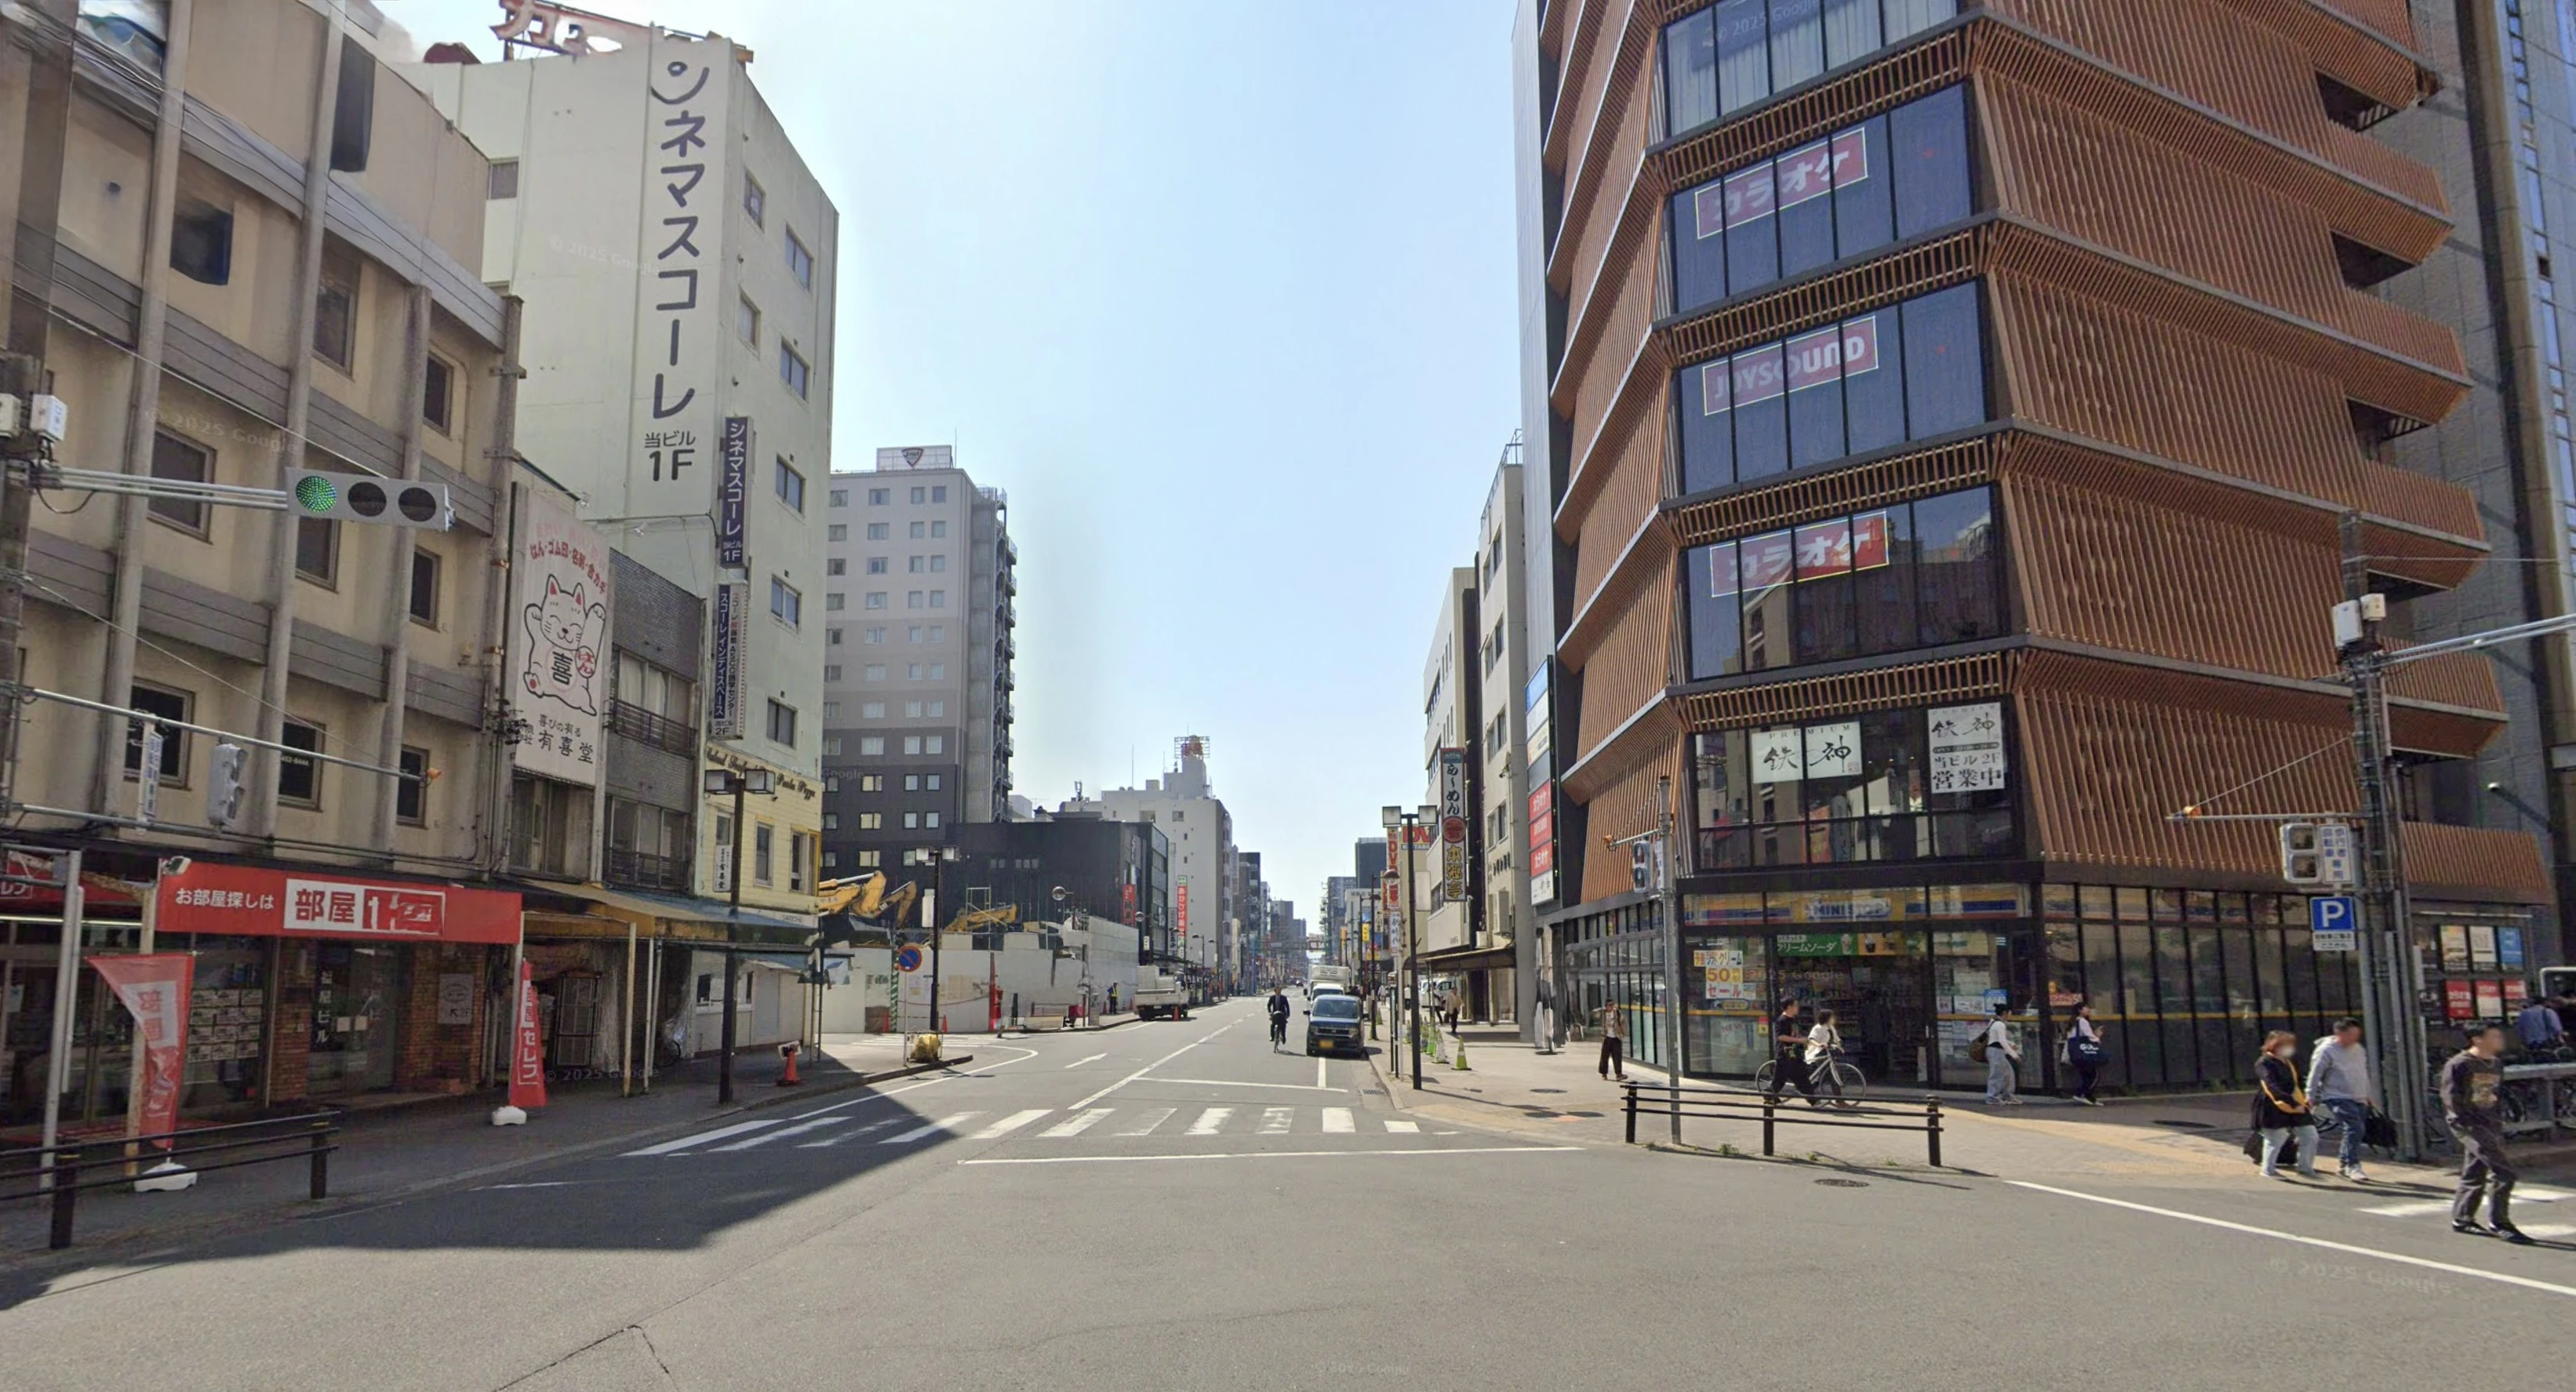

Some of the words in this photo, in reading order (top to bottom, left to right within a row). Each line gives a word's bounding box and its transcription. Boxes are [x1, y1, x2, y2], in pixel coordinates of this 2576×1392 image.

[1715, 150, 1850, 221] カラオケ
[650, 61, 709, 419] シネマスコーレ
[644, 431, 696, 448] 当ビル
[649, 449, 696, 482] 1F
[726, 422, 745, 536] シネマスコーレ
[723, 551, 740, 562] 1F
[1730, 525, 1871, 583] カラオケ
[552, 651, 573, 685] 喜
[538, 729, 593, 764] 有喜堂
[1769, 725, 1850, 739] PREMIUM
[1934, 754, 1977, 769] 当ビル
[1932, 768, 2002, 790] 営業中
[1446, 845, 1464, 899] 本郷亭
[175, 888, 275, 910] お部屋探しは
[295, 889, 355, 924] 部屋
[2321, 900, 2345, 928] P
[1777, 942, 1837, 952] クリームソーダ
[1708, 983, 1742, 998] セール
